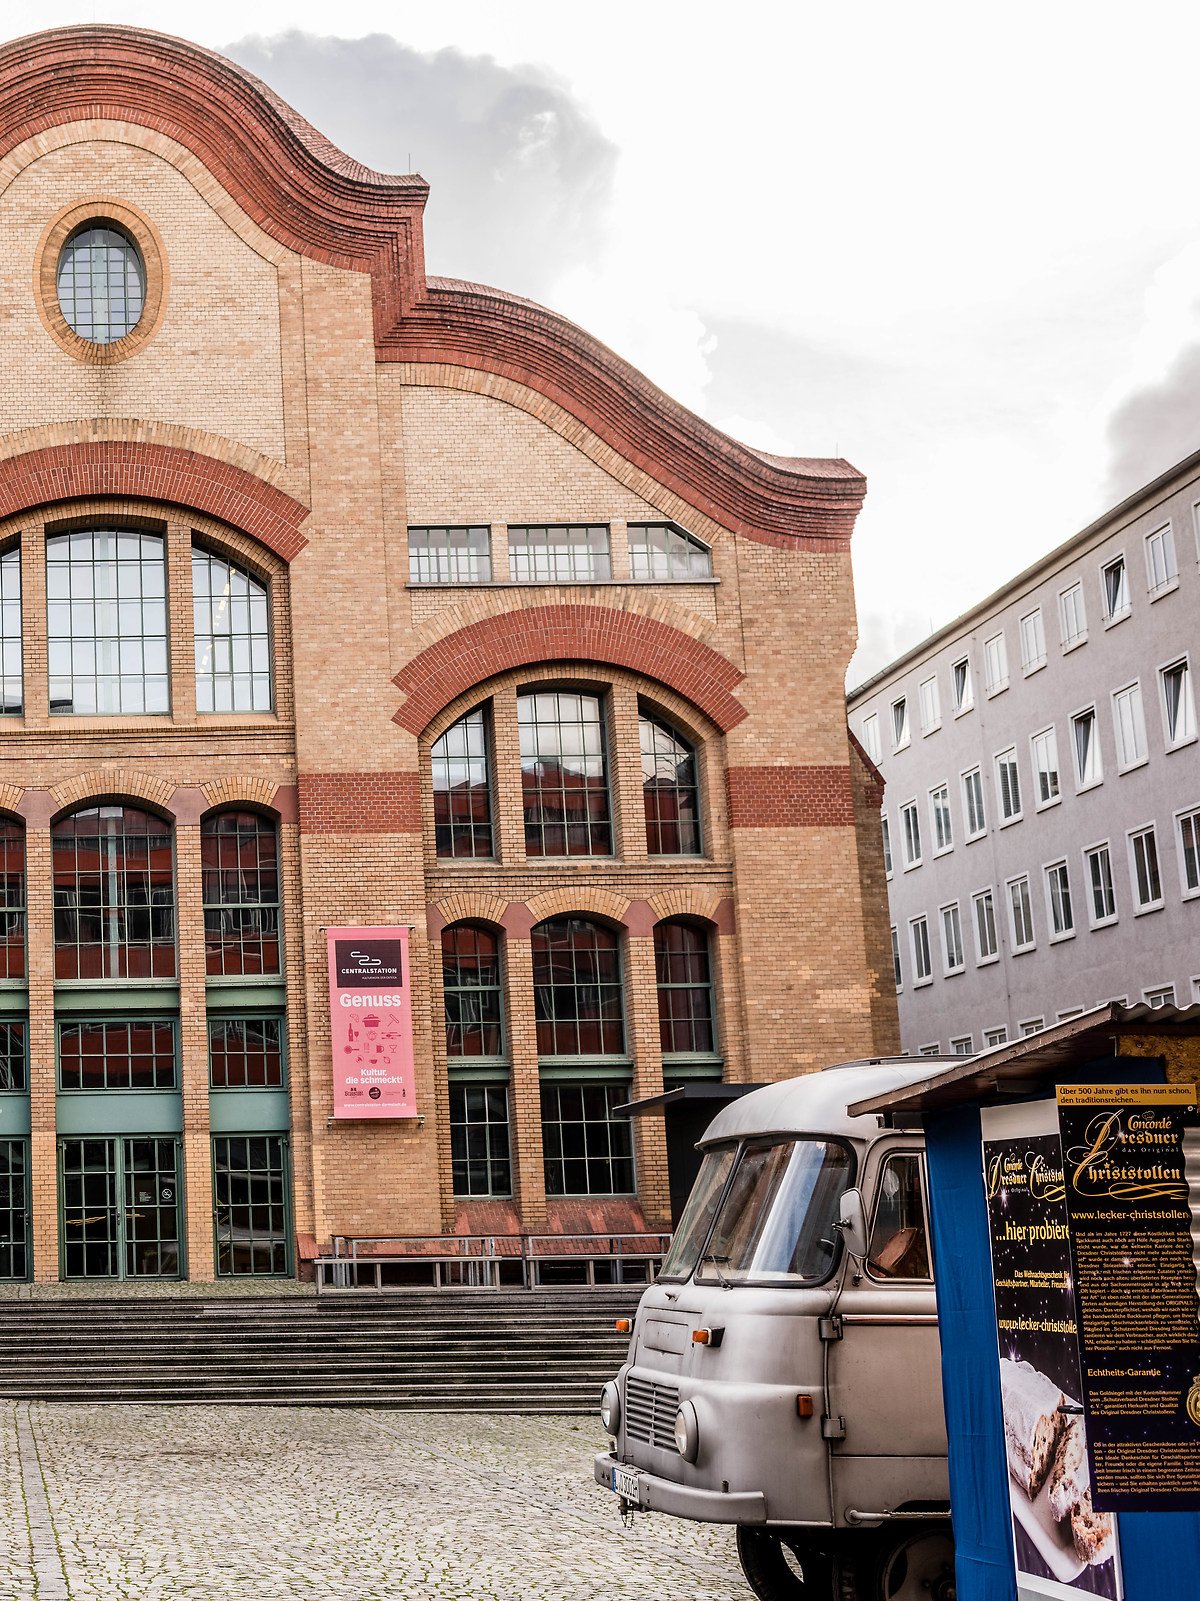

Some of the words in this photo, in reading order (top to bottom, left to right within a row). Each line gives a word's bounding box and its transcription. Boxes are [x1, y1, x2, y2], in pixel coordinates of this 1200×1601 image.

[340, 994, 401, 1007] Genuss
[360, 1076, 403, 1084] schmeckt!
[1128, 1115, 1172, 1131] Concorde
[996, 1221, 1027, 1240] ...hier
[1088, 1368, 1161, 1377] Echtheits-Garantie
